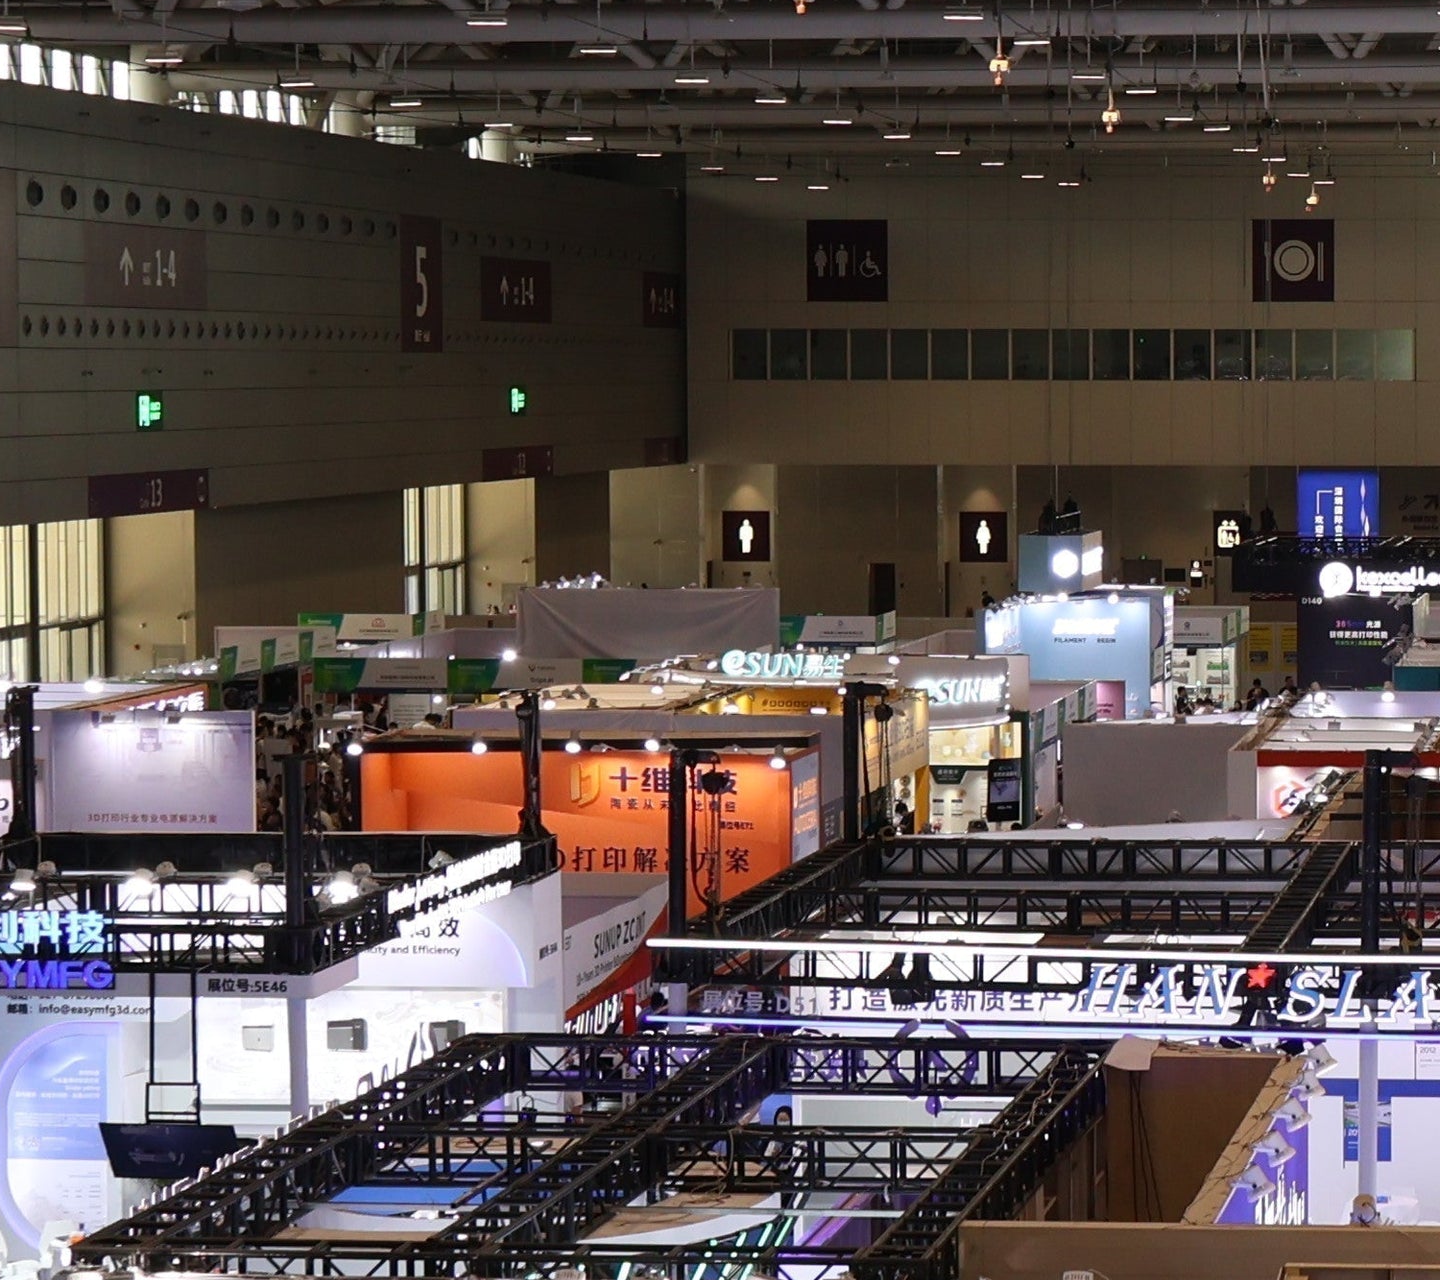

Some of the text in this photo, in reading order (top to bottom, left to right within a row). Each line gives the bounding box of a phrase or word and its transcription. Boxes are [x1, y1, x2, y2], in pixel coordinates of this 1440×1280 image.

[156, 249, 177, 287] 1-4
[415, 245, 428, 318] 5
[412, 944, 460, 958] Efficiency
